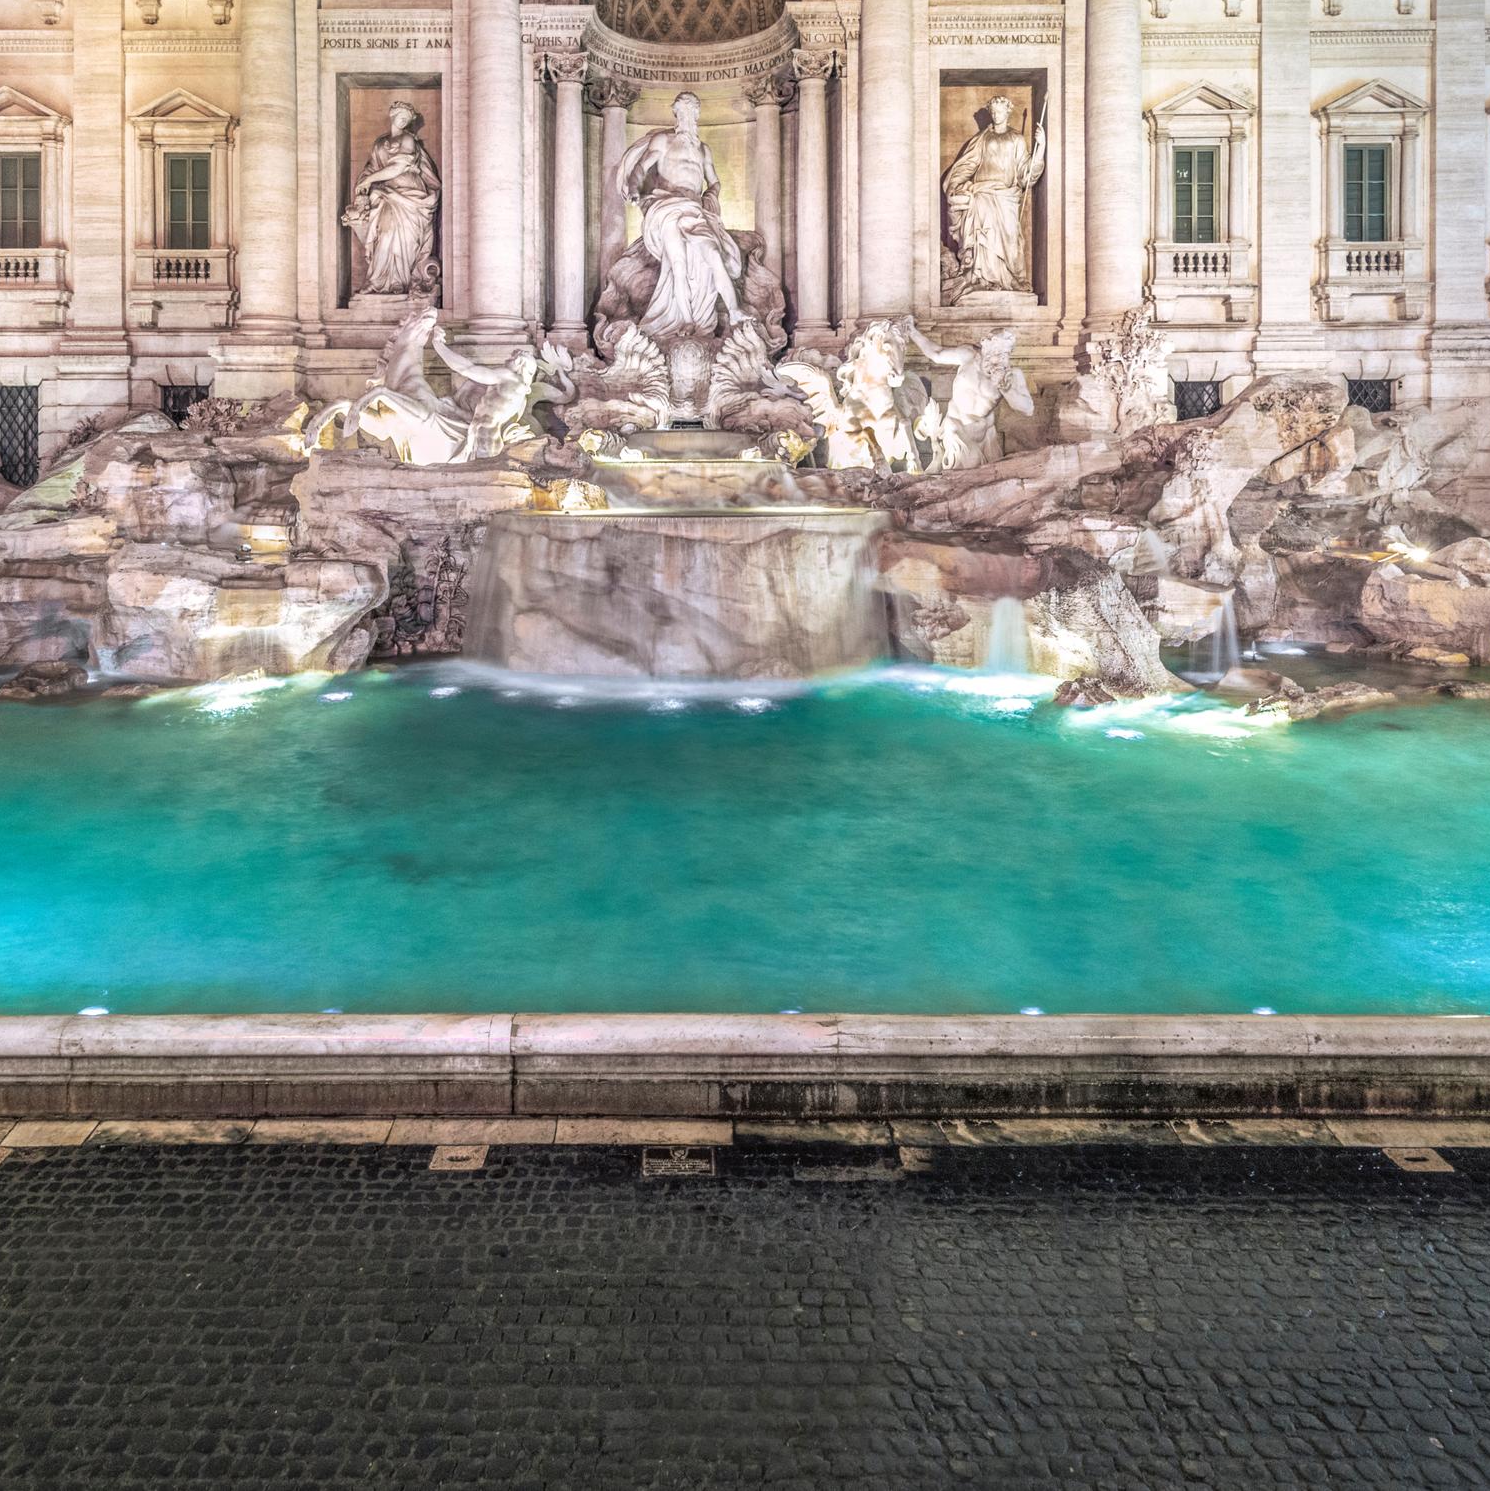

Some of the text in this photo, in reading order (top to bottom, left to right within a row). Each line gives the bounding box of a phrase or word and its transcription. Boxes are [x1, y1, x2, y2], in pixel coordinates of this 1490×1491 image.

[323, 38, 361, 49] POSITIS
[366, 38, 399, 49] SIGNIS
[406, 38, 418, 49] ET
[426, 38, 452, 49] ANA
